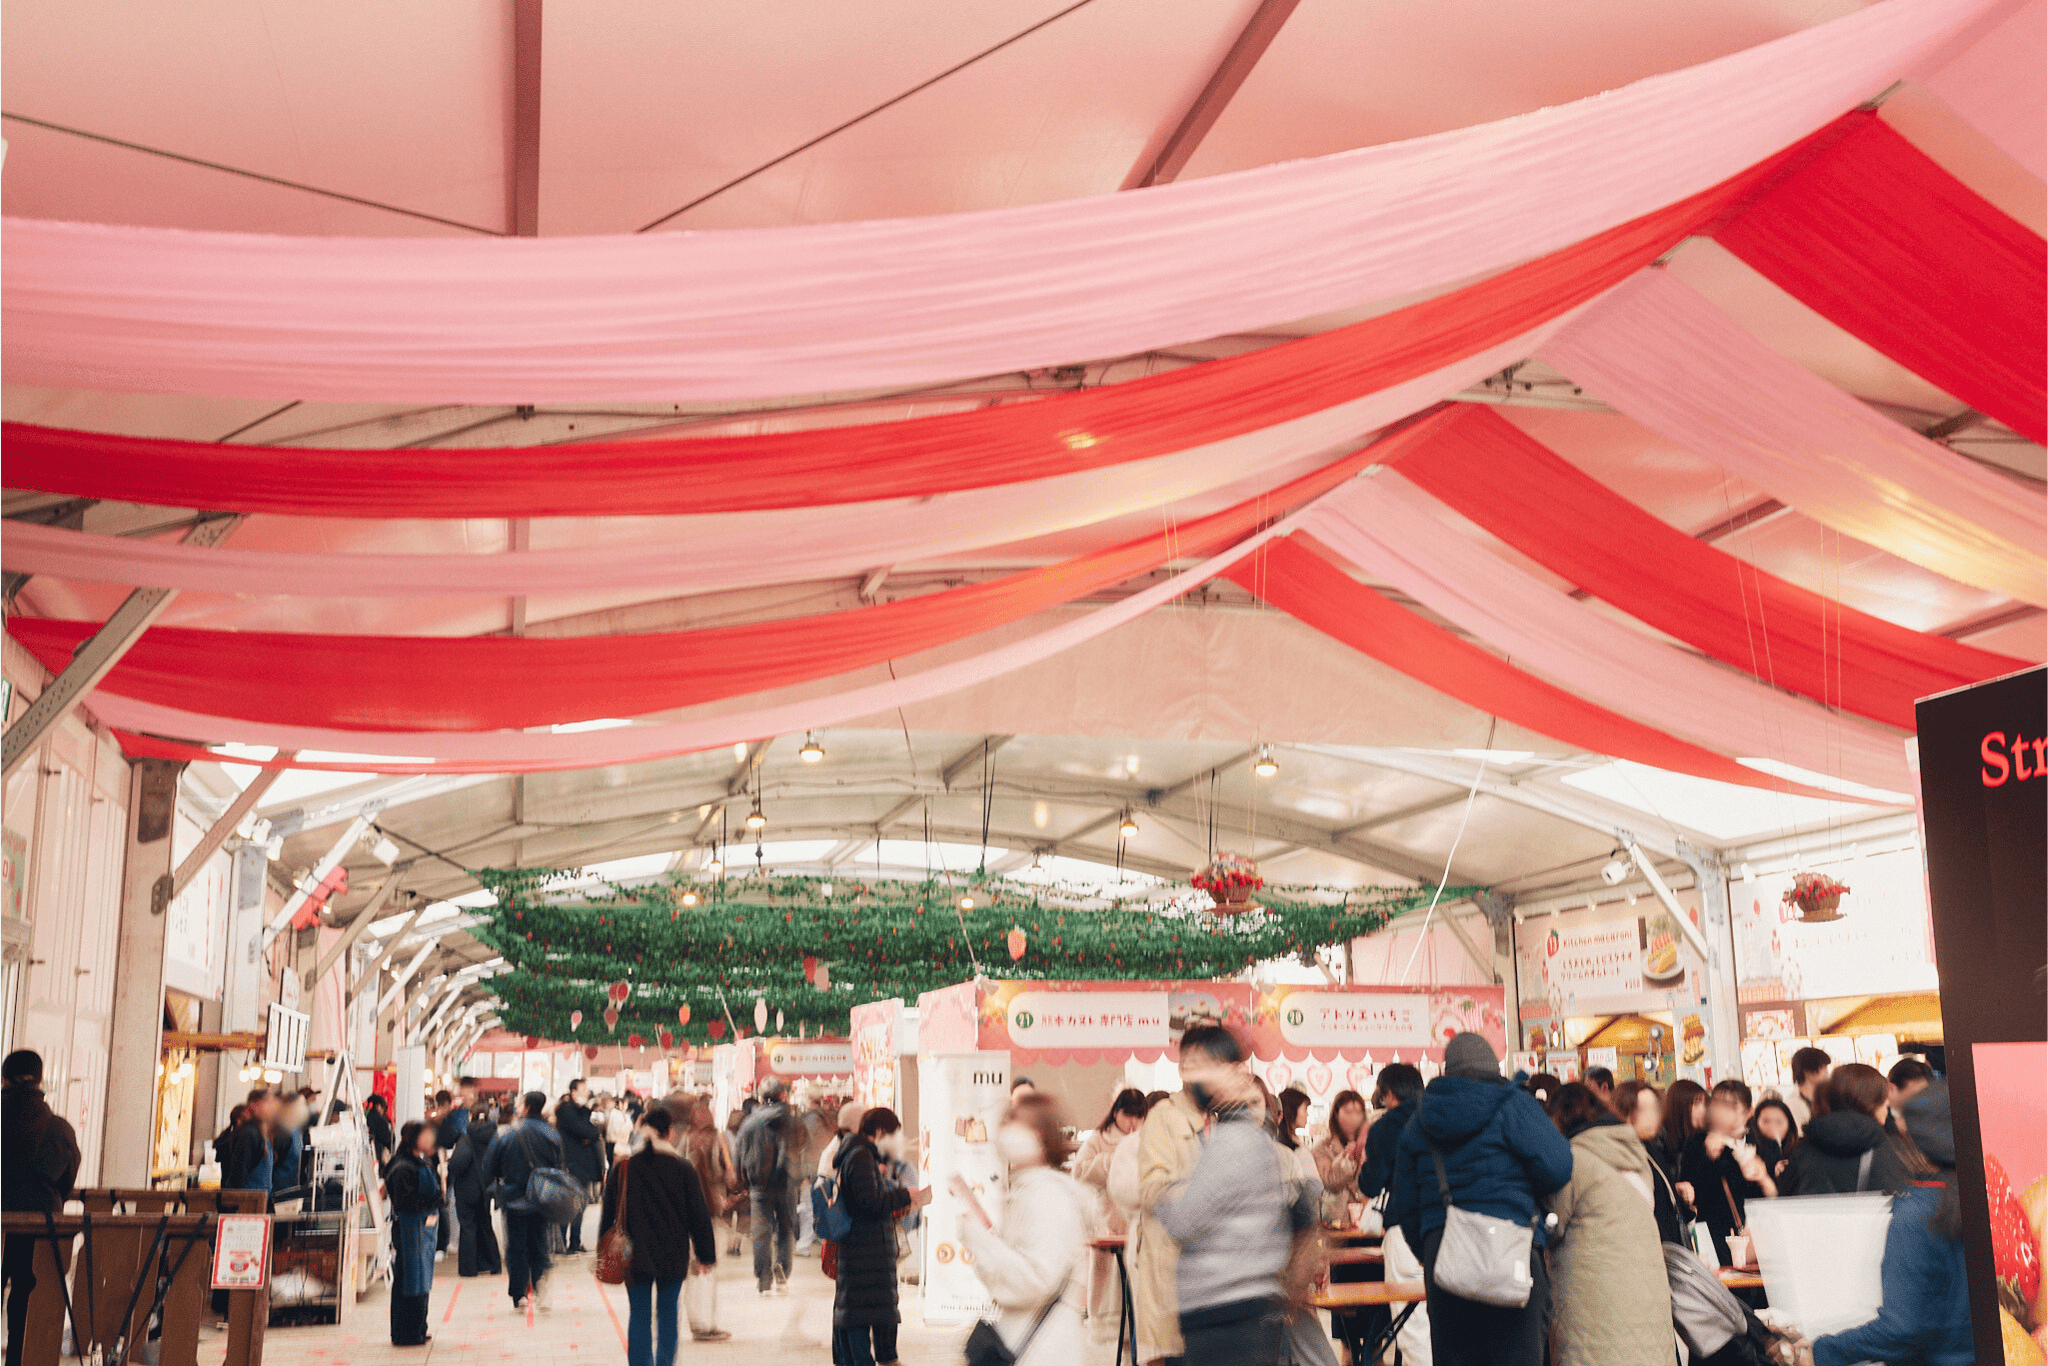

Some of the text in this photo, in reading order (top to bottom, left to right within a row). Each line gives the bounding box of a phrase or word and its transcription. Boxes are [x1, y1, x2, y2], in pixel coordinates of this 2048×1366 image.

[1018, 1013, 1031, 1027] 21
[1138, 1017, 1161, 1026] mu
[1320, 1008, 1410, 1023] アトリエいちご
[973, 1070, 1003, 1086] mu
